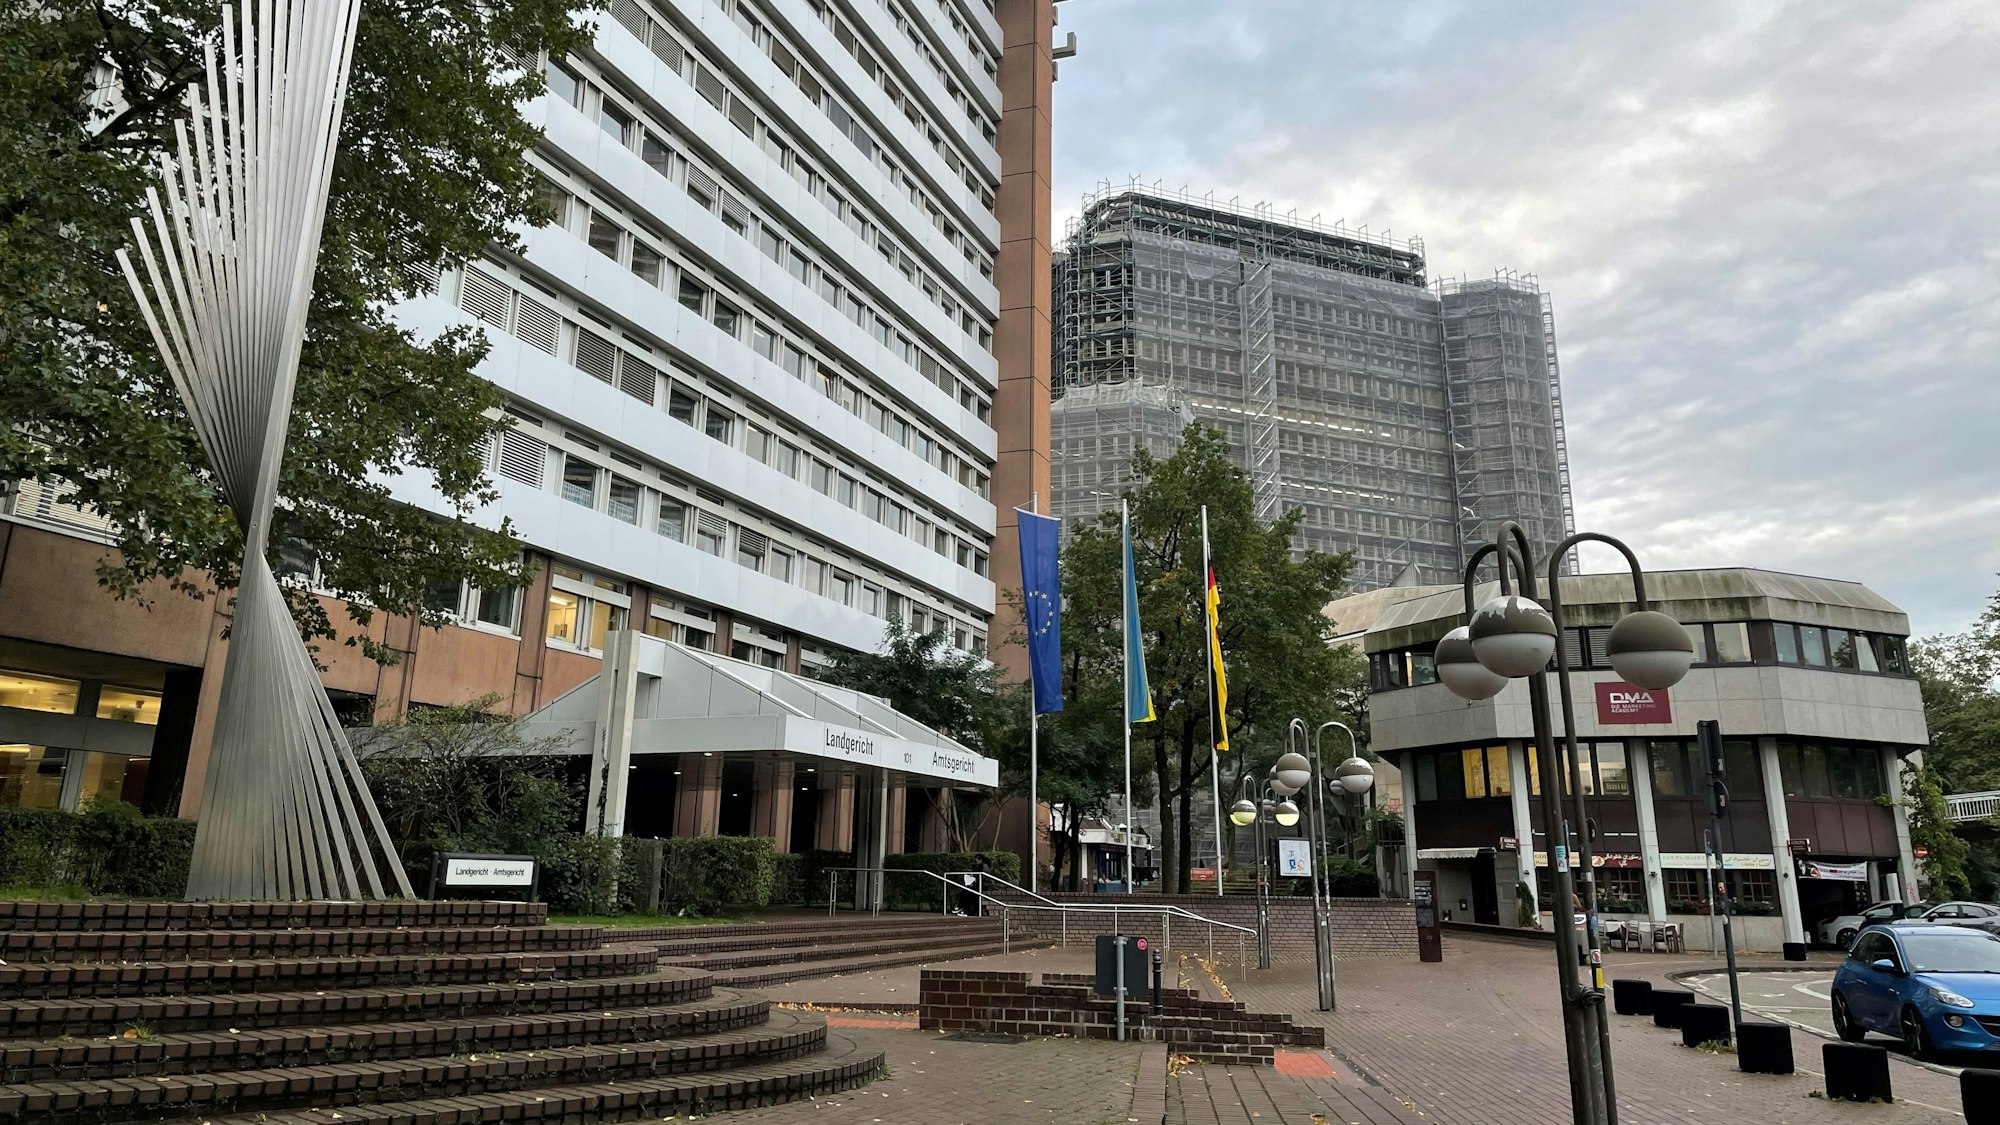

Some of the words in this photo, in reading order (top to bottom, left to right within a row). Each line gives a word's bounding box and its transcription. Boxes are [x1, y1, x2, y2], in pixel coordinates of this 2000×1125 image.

[1609, 692, 1654, 703] DMA
[826, 728, 873, 756] Landgericht
[903, 752, 912, 764] 101
[932, 751, 975, 774] Amtsgericht
[455, 867, 488, 877] Landgericht
[493, 868, 525, 877] Amtsgericht
